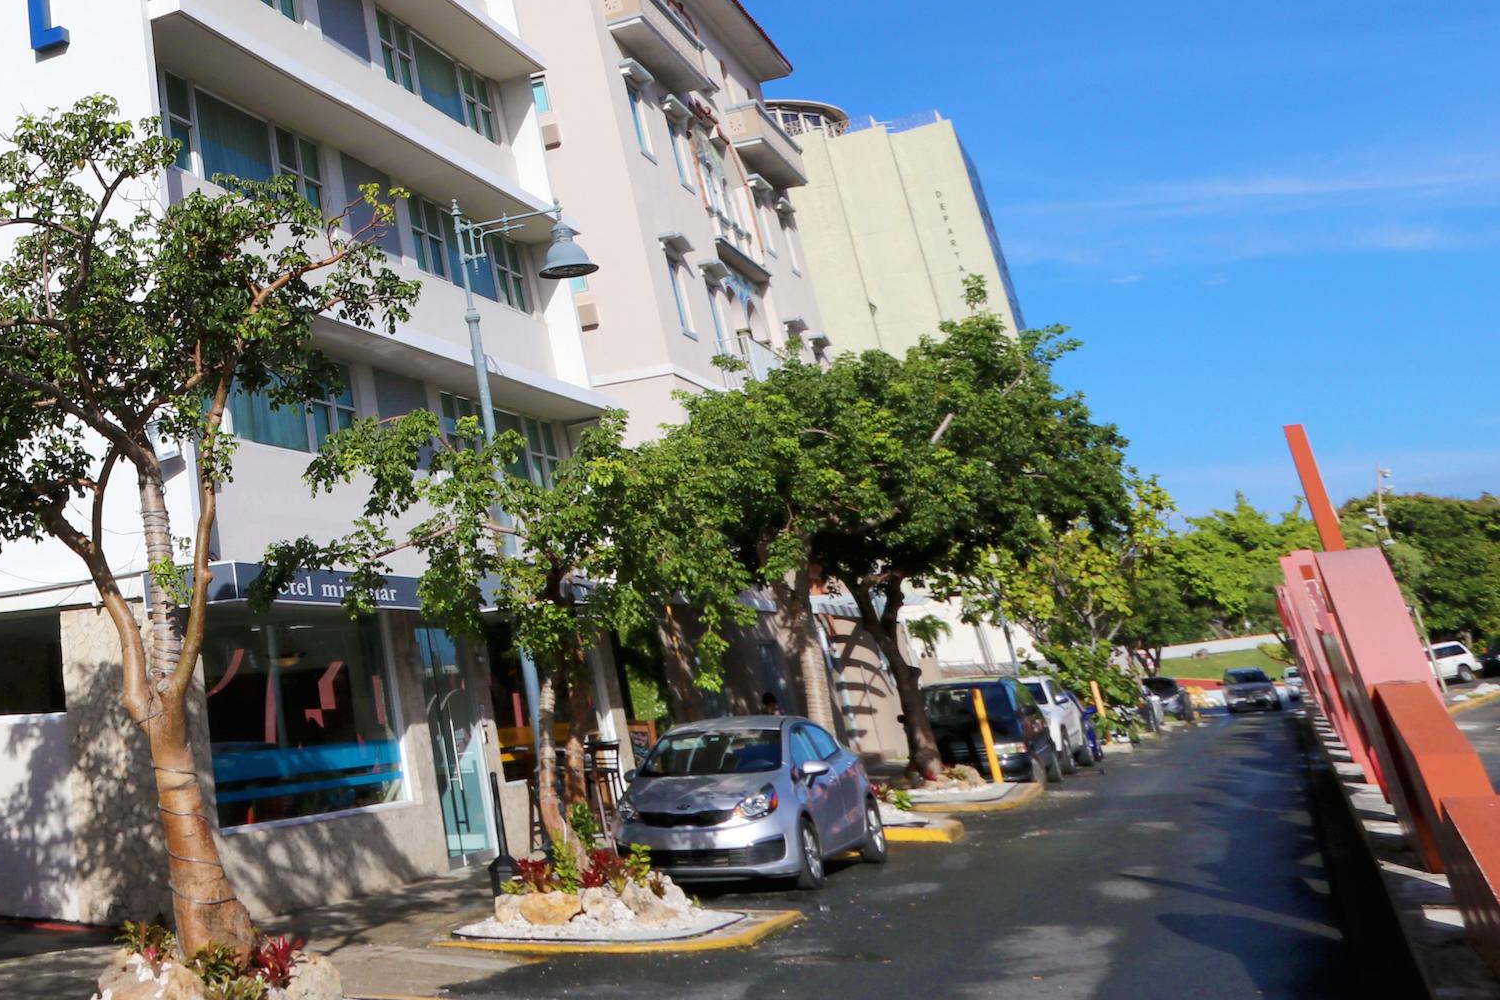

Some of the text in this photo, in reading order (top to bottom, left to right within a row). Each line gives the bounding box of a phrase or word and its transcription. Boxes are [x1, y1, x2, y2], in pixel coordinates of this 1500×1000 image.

[935, 190, 966, 276] DEPARTA
[273, 575, 397, 602] otel mimar
